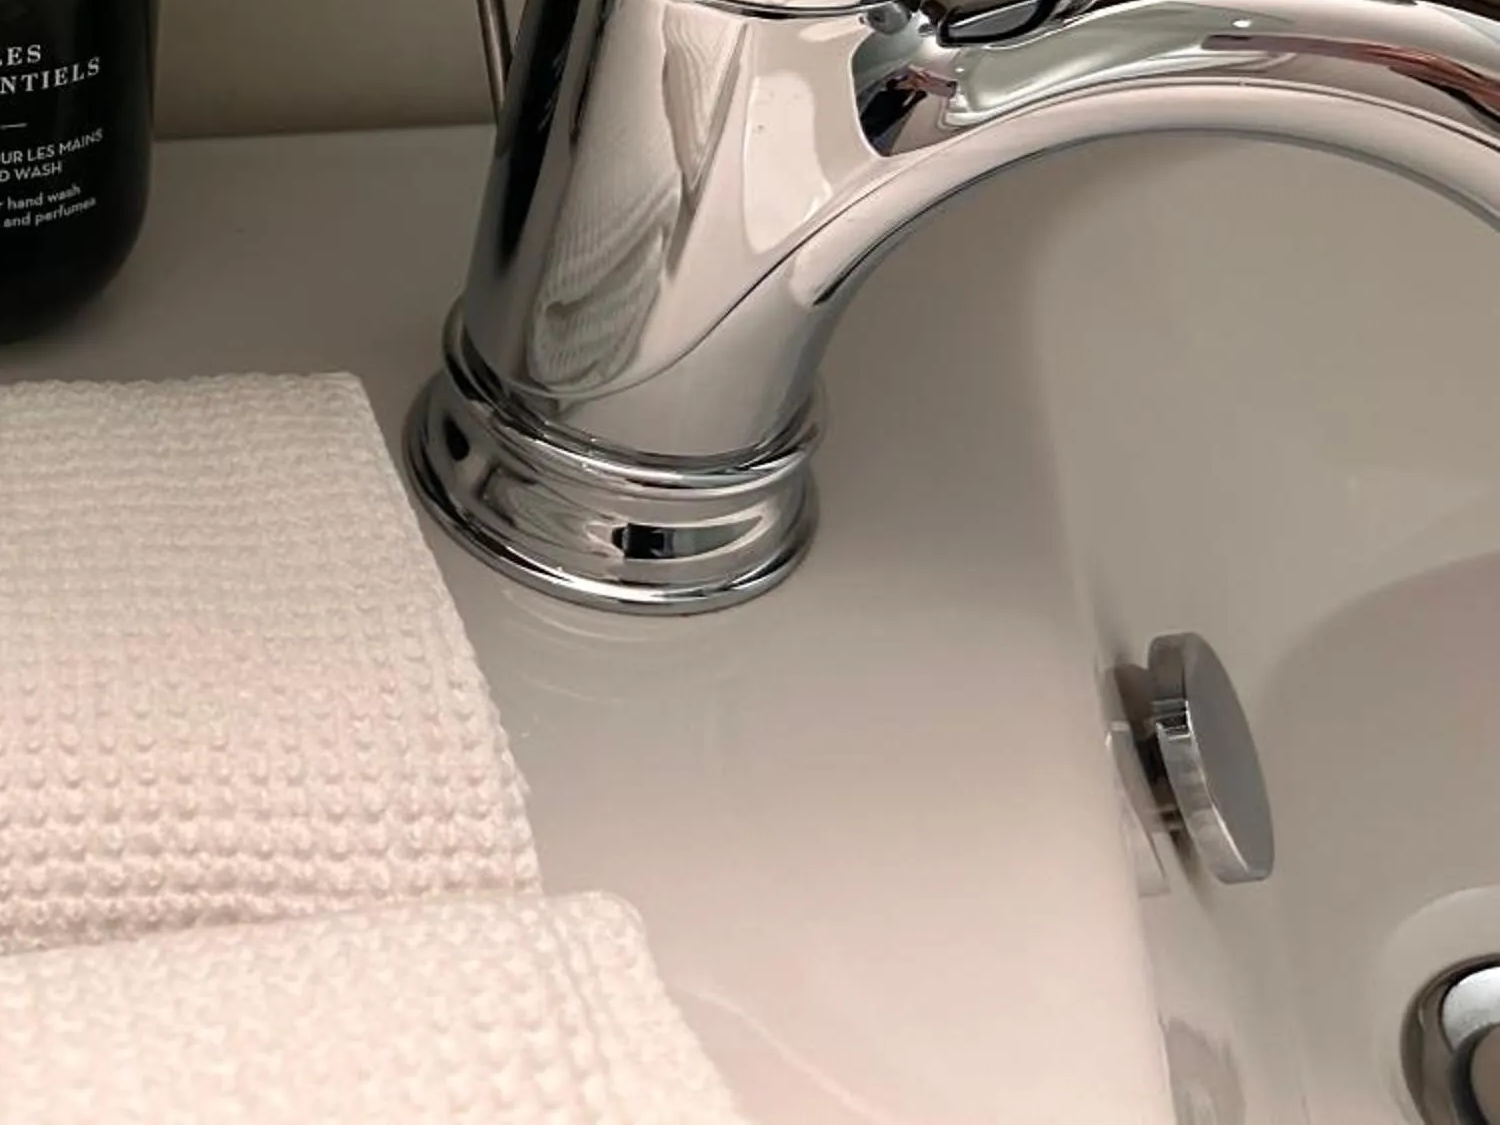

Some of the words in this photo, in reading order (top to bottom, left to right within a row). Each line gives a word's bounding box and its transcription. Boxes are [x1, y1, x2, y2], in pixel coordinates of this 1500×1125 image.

[26, 144, 56, 162] LES
[59, 127, 103, 155] MAINS
[14, 159, 63, 180] WASH
[6, 190, 44, 210] hand
[47, 182, 82, 203] wash
[3, 210, 32, 228] and
[34, 196, 97, 226] perfumes
